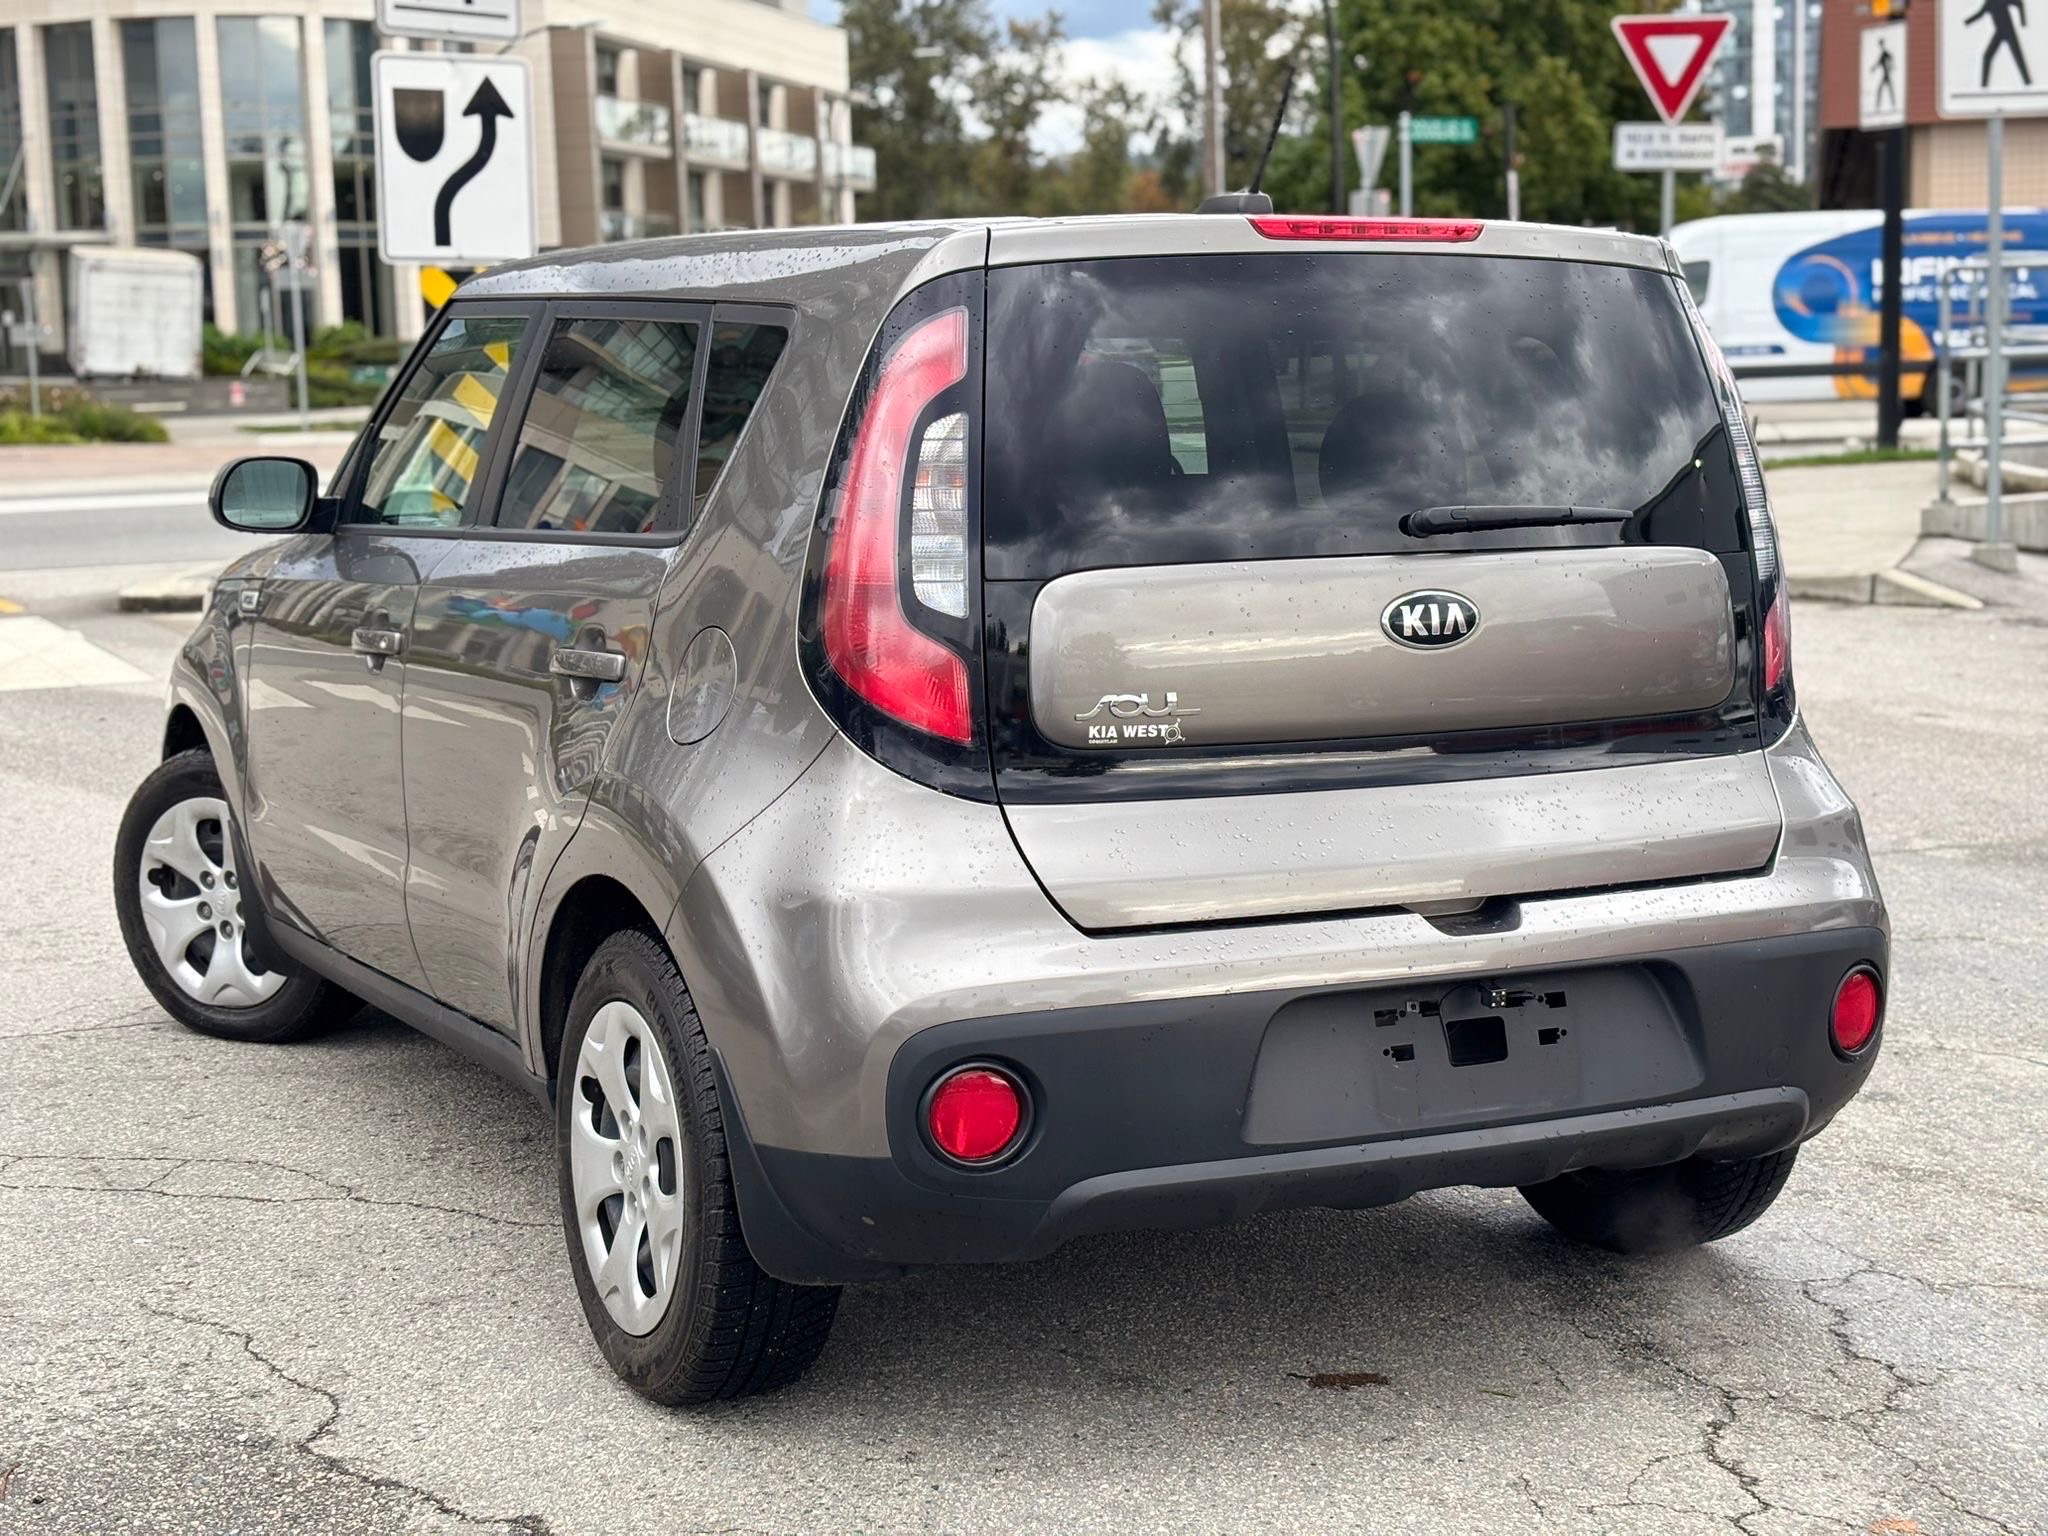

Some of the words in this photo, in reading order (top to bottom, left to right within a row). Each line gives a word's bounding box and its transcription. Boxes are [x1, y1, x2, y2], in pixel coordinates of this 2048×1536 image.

[1400, 602, 1467, 636] KIA
[1088, 725, 1118, 738] KIA
[1123, 724, 1168, 738] WEST
